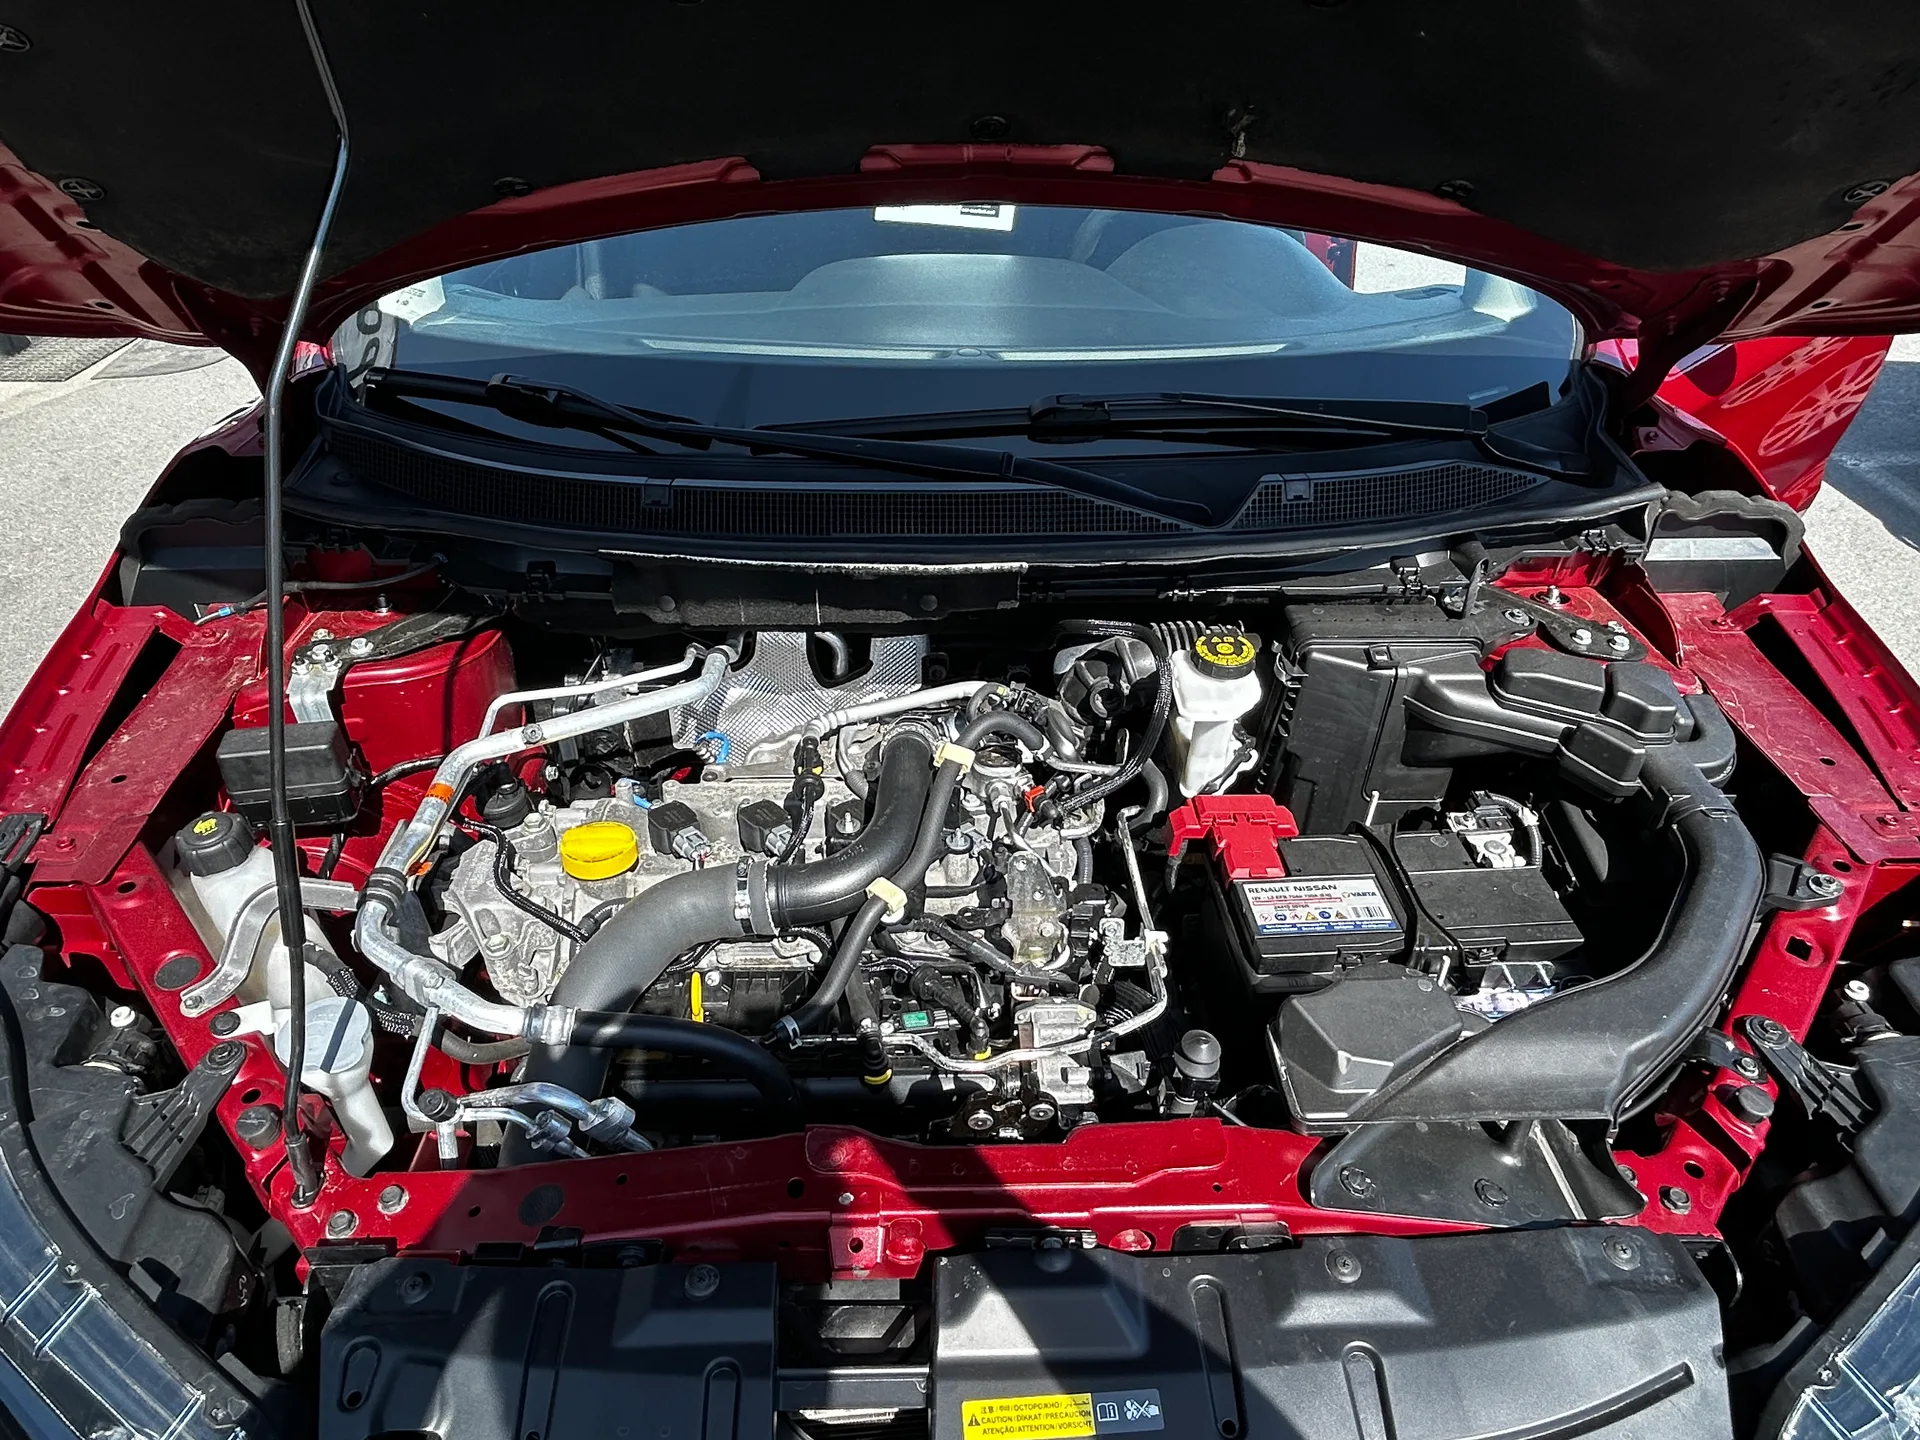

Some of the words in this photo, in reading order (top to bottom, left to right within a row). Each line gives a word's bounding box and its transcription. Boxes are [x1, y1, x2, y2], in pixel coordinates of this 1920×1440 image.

[1293, 884, 1337, 892] NISSAN
[981, 1415, 1013, 1424] CAUTION
[1017, 1423, 1055, 1433] ATTENTION
[1057, 1420, 1092, 1430] VORSICHT
